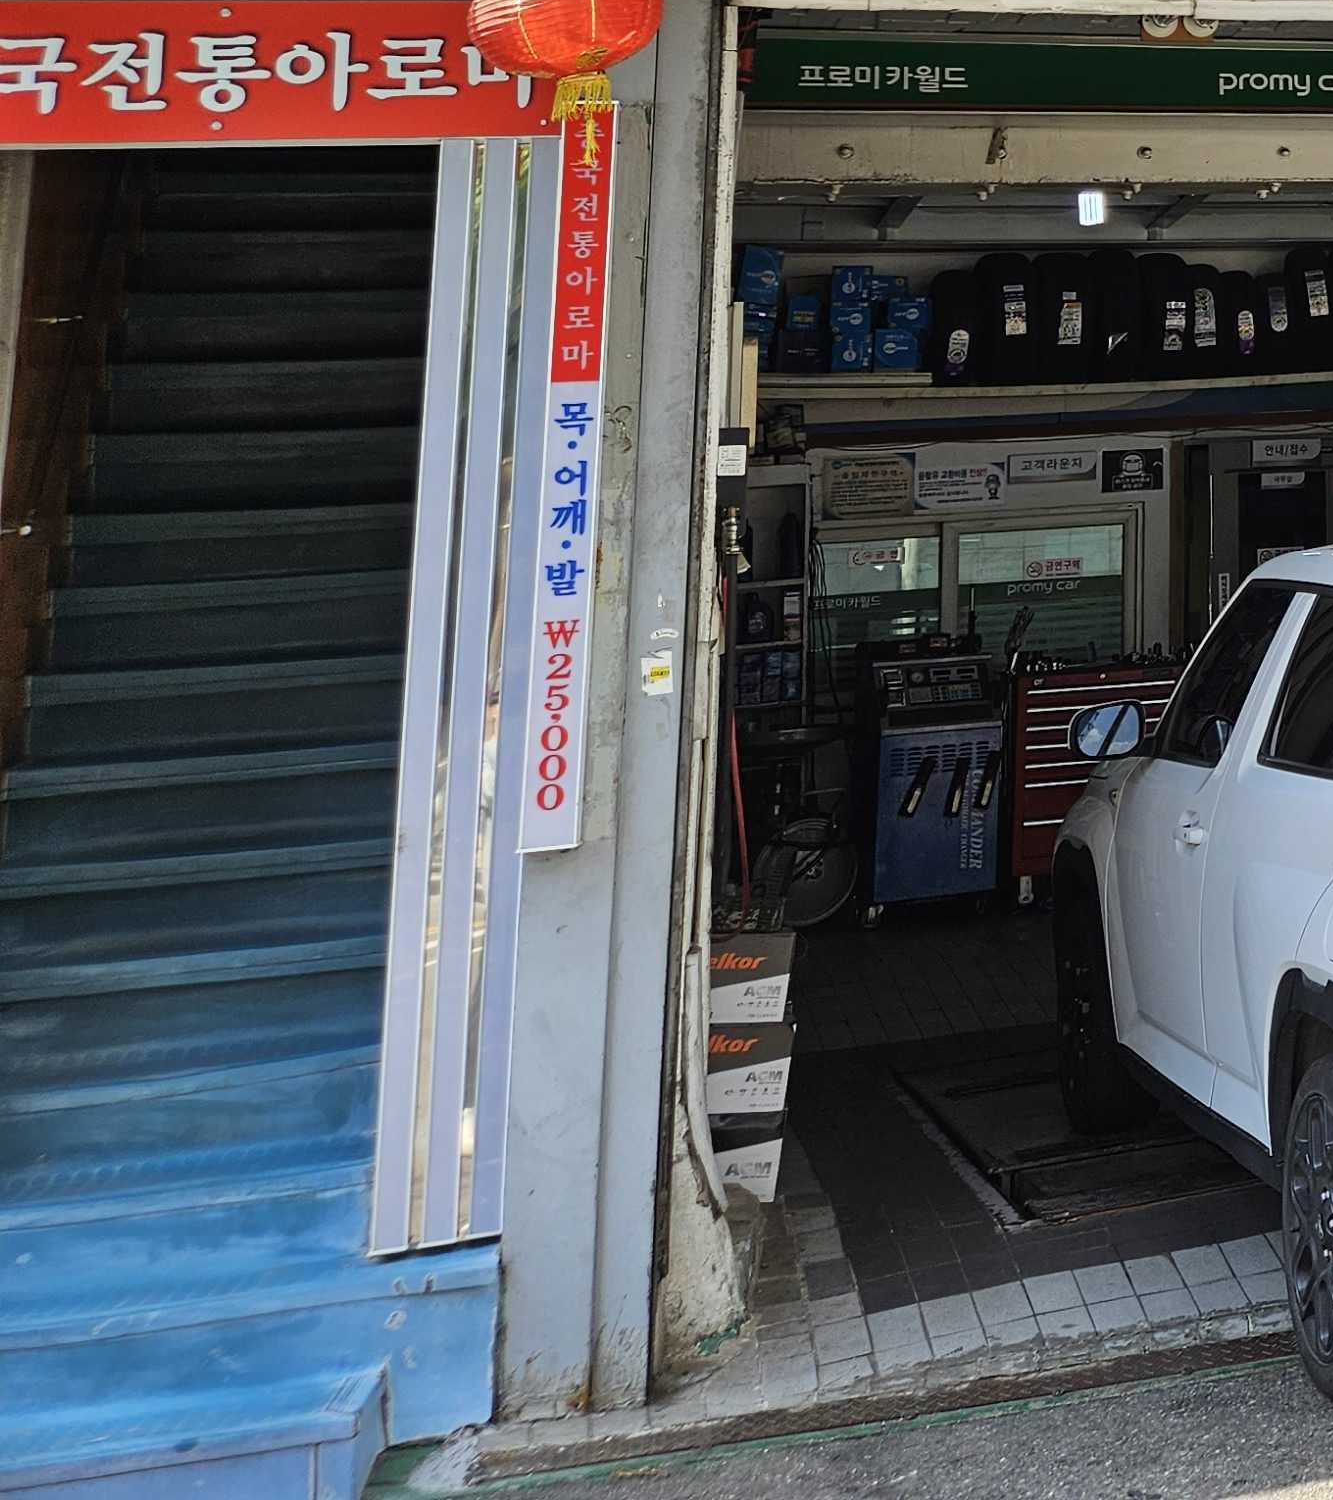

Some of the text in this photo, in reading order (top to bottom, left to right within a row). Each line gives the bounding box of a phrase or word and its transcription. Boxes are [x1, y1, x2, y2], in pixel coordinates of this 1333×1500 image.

[798, 63, 969, 94] 프로미카월드
[1218, 70, 1311, 98] promy
[1020, 456, 1084, 473] 고객라운지
[1007, 577, 1081, 598] promy car
[709, 952, 768, 970] elkor
[707, 1034, 762, 1054] lkor
